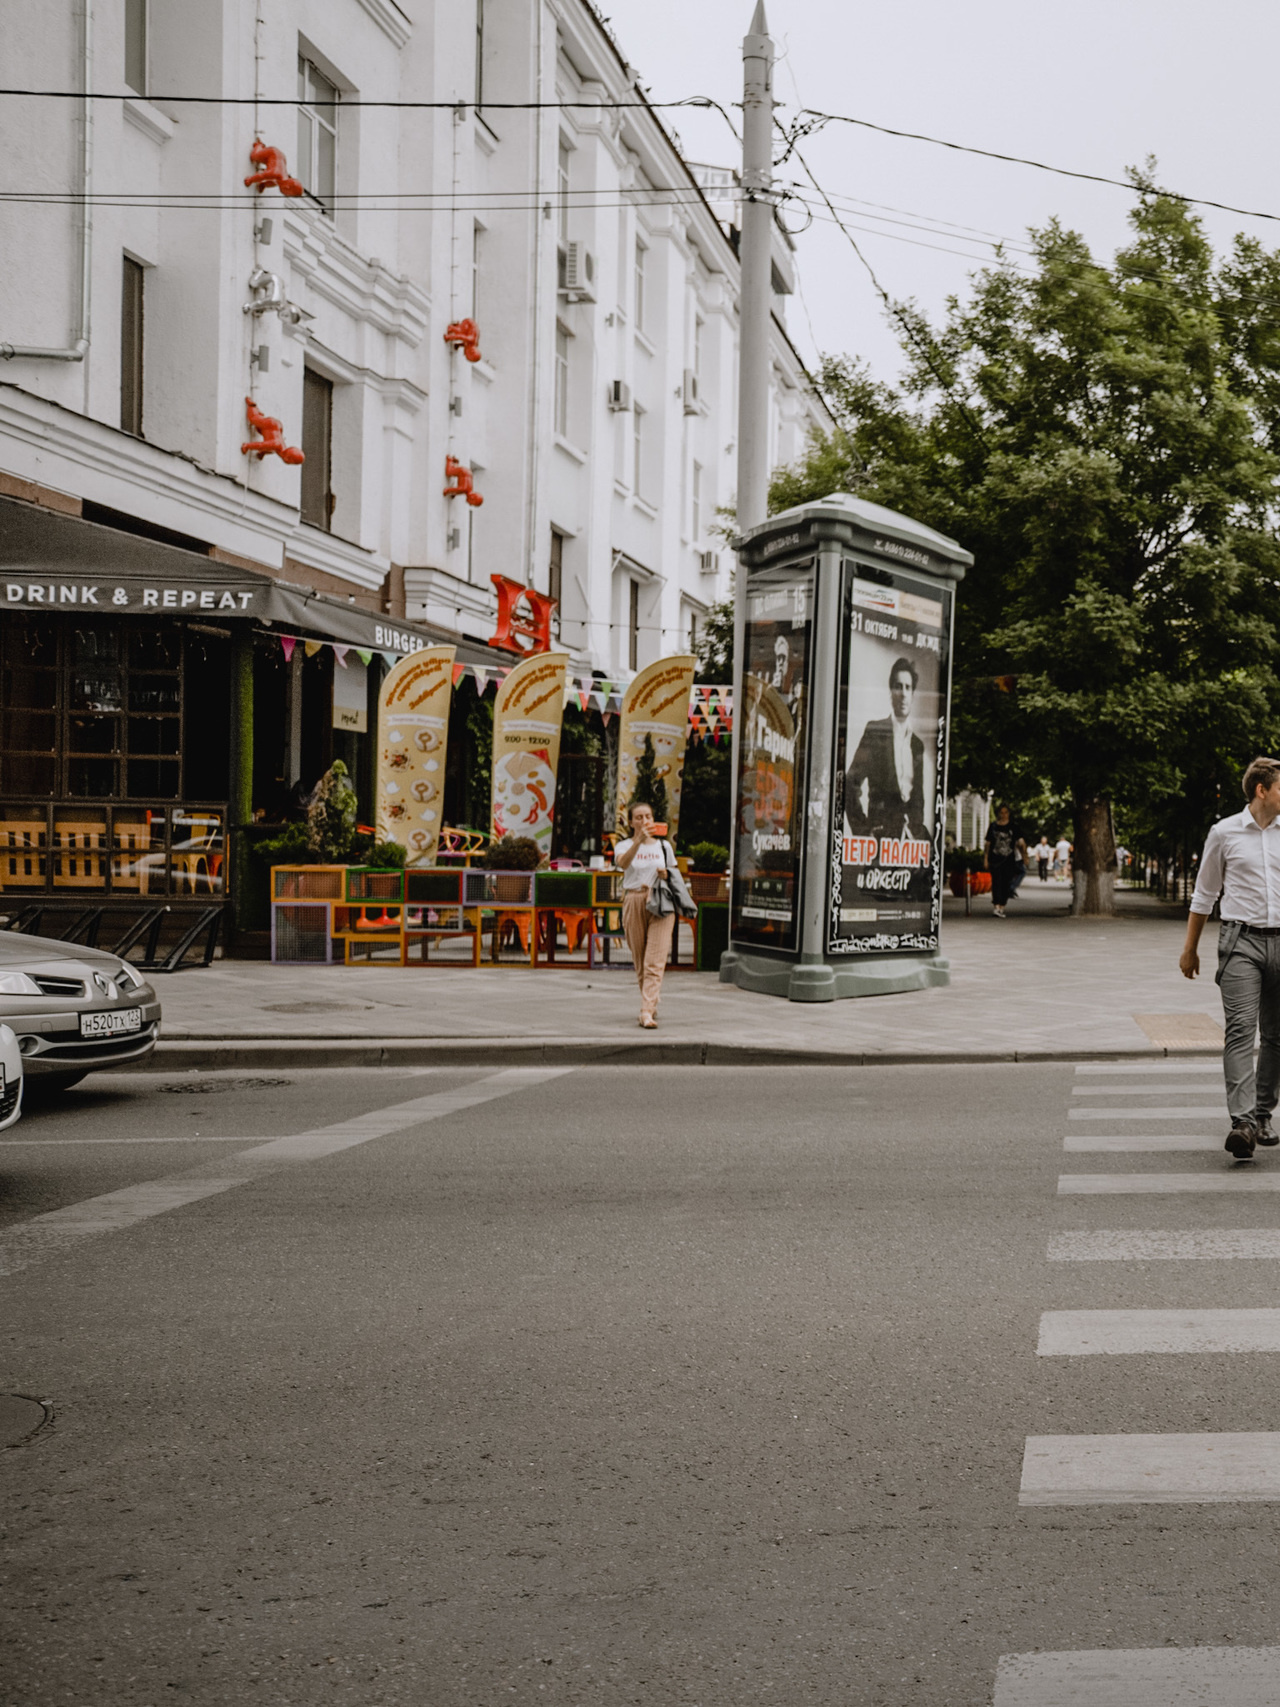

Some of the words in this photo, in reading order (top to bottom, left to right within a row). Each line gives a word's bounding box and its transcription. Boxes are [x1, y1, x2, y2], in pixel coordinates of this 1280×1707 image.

[6, 584, 99, 604] DRINK
[111, 588, 129, 605] &
[143, 588, 254, 610] REPEAT
[793, 584, 806, 613] 15
[375, 625, 424, 654] BURGER
[850, 610, 863, 632] 31
[864, 618, 899, 641] ОКТЯБРЯ
[757, 713, 795, 764] Гарик
[752, 827, 791, 857] Сукачёв
[879, 837, 931, 868] НАЛИЧ
[865, 867, 912, 891] ОРКЕСТР
[85, 1013, 126, 1032] H520TX
[127, 1009, 140, 1022] 123
